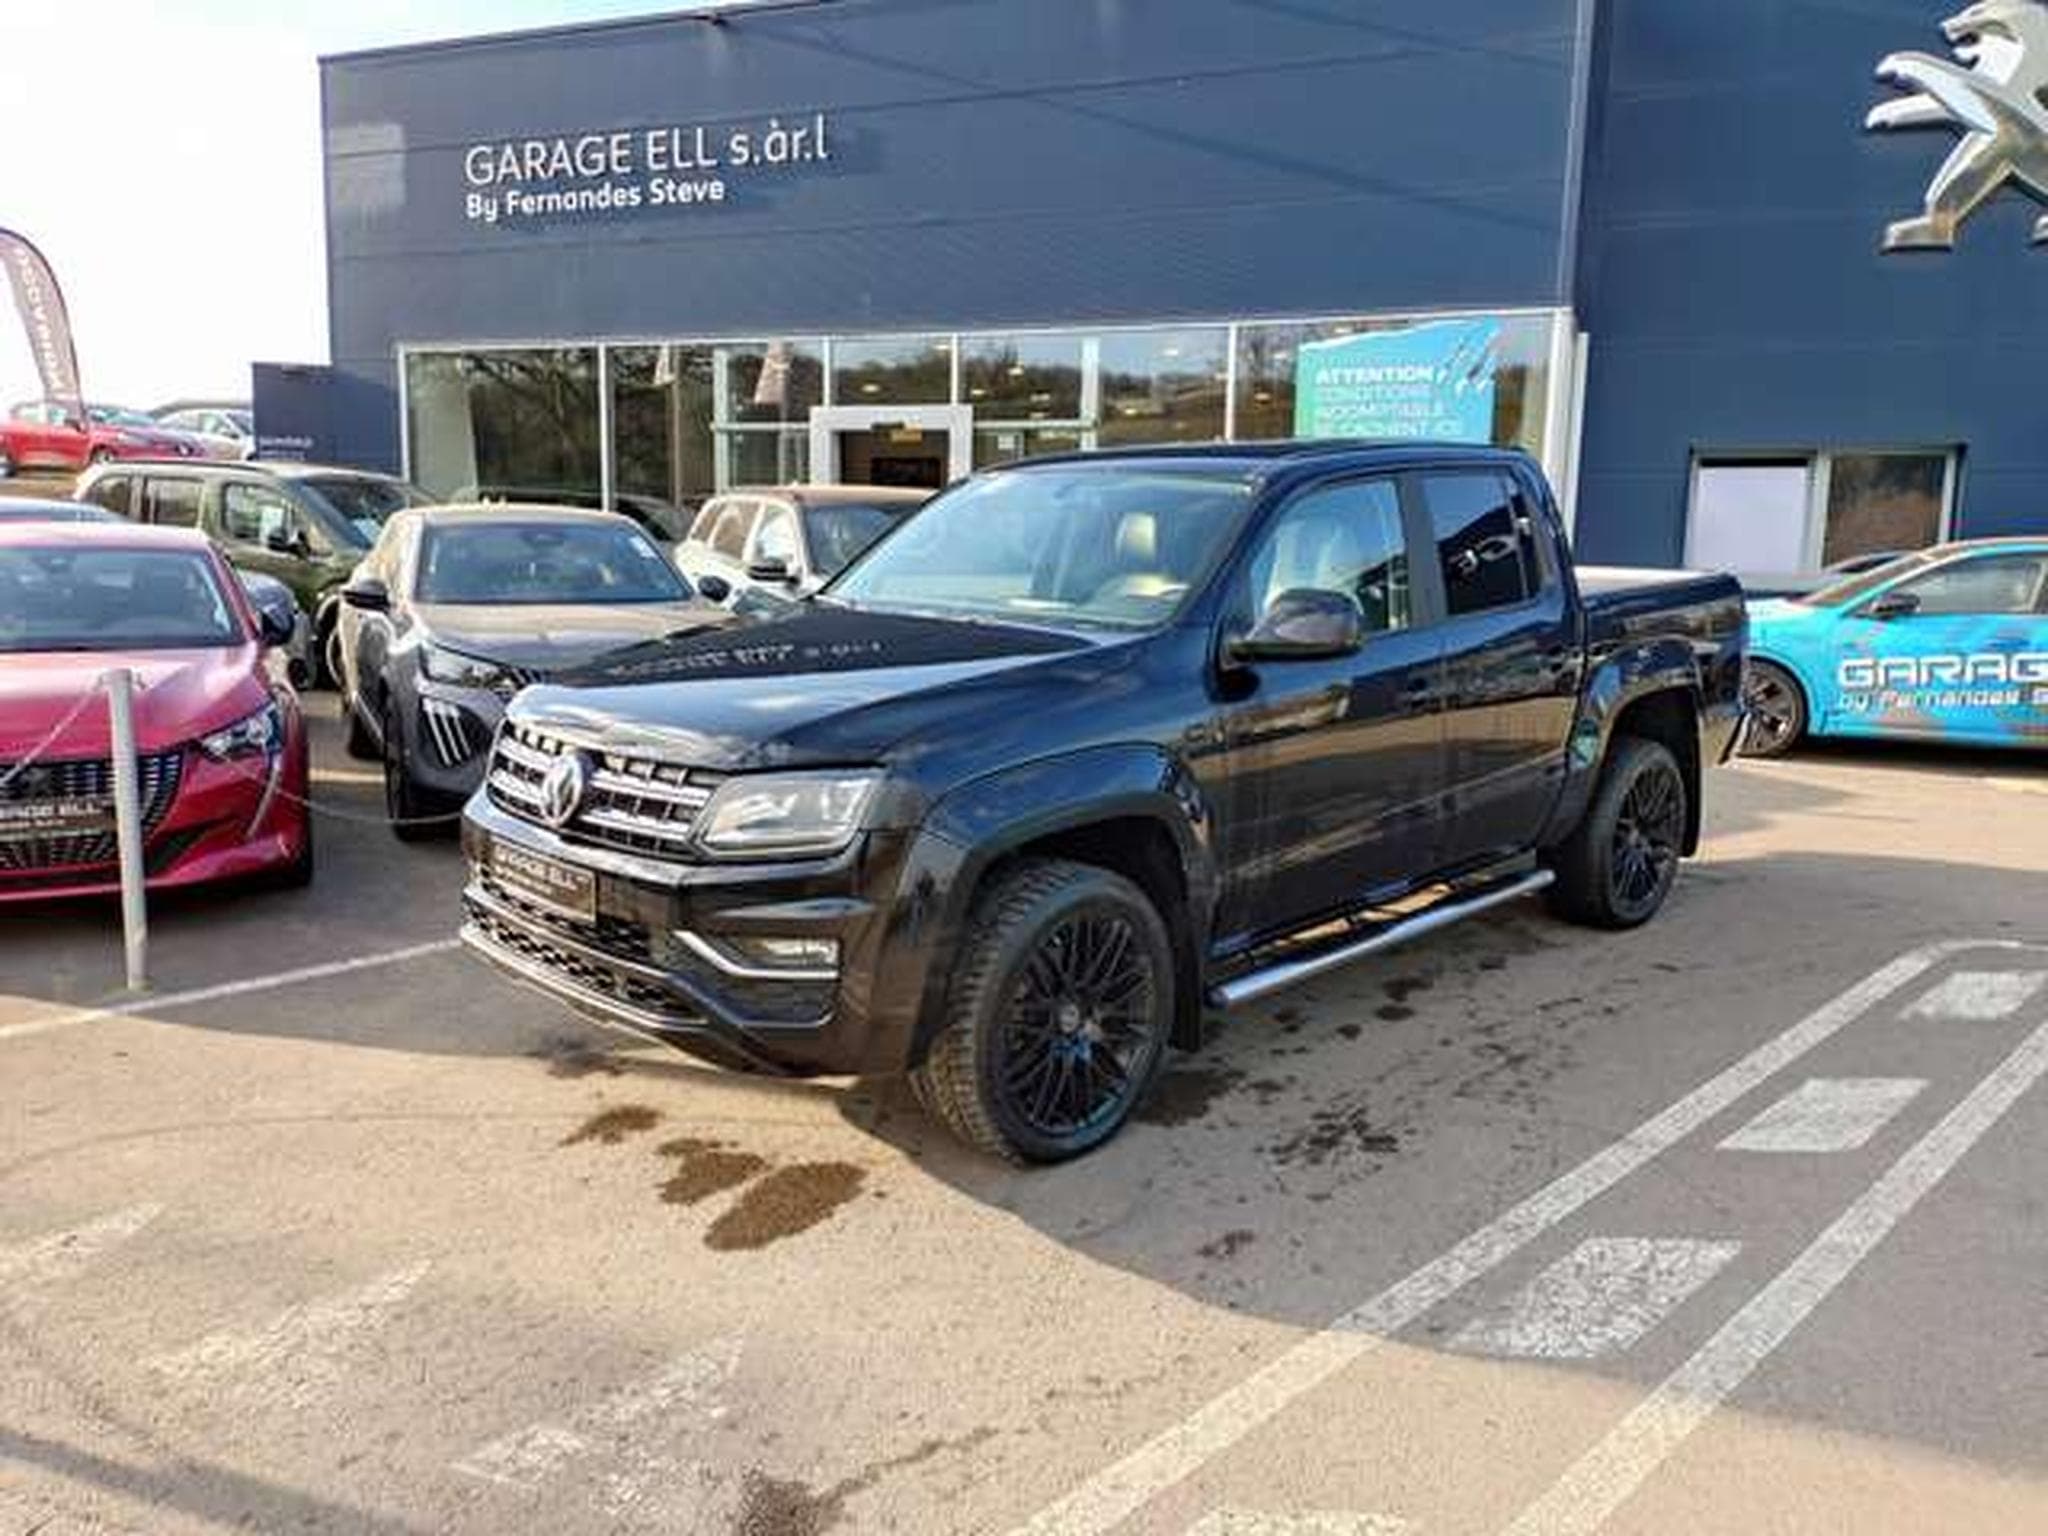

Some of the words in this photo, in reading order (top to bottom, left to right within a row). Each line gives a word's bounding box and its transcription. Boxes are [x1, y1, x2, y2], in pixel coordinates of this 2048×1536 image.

[465, 133, 632, 185] GARAGE
[647, 127, 718, 171] ELL
[466, 193, 497, 222] By
[506, 182, 642, 215] Fernandes
[650, 178, 725, 204] Steve
